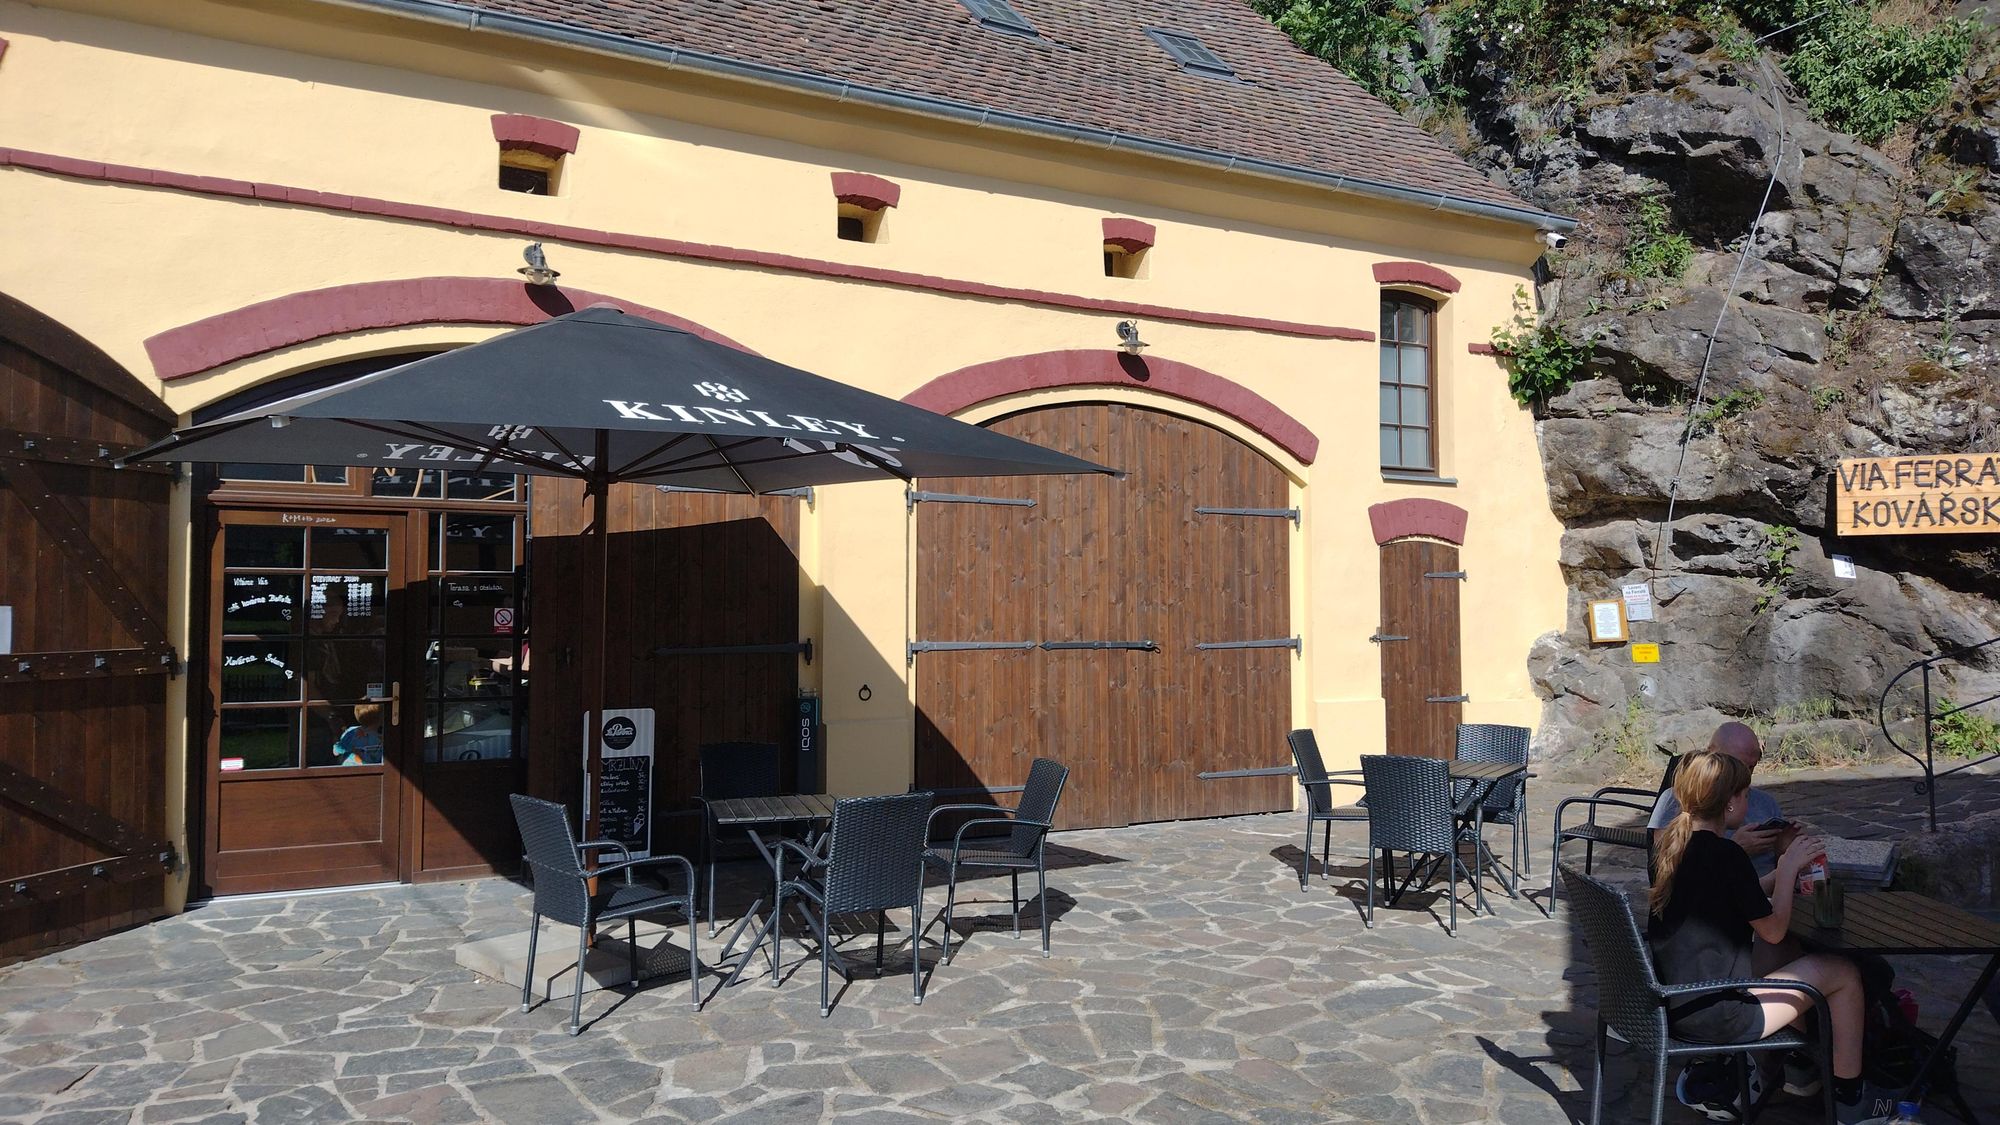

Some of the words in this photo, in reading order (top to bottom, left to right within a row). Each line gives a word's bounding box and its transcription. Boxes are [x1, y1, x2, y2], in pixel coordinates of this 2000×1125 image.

[602, 399, 880, 440] KINLEY
[1838, 462, 1889, 492] VIA
[1895, 456, 2000, 489] FERRA
[801, 718, 811, 751] IQOS
